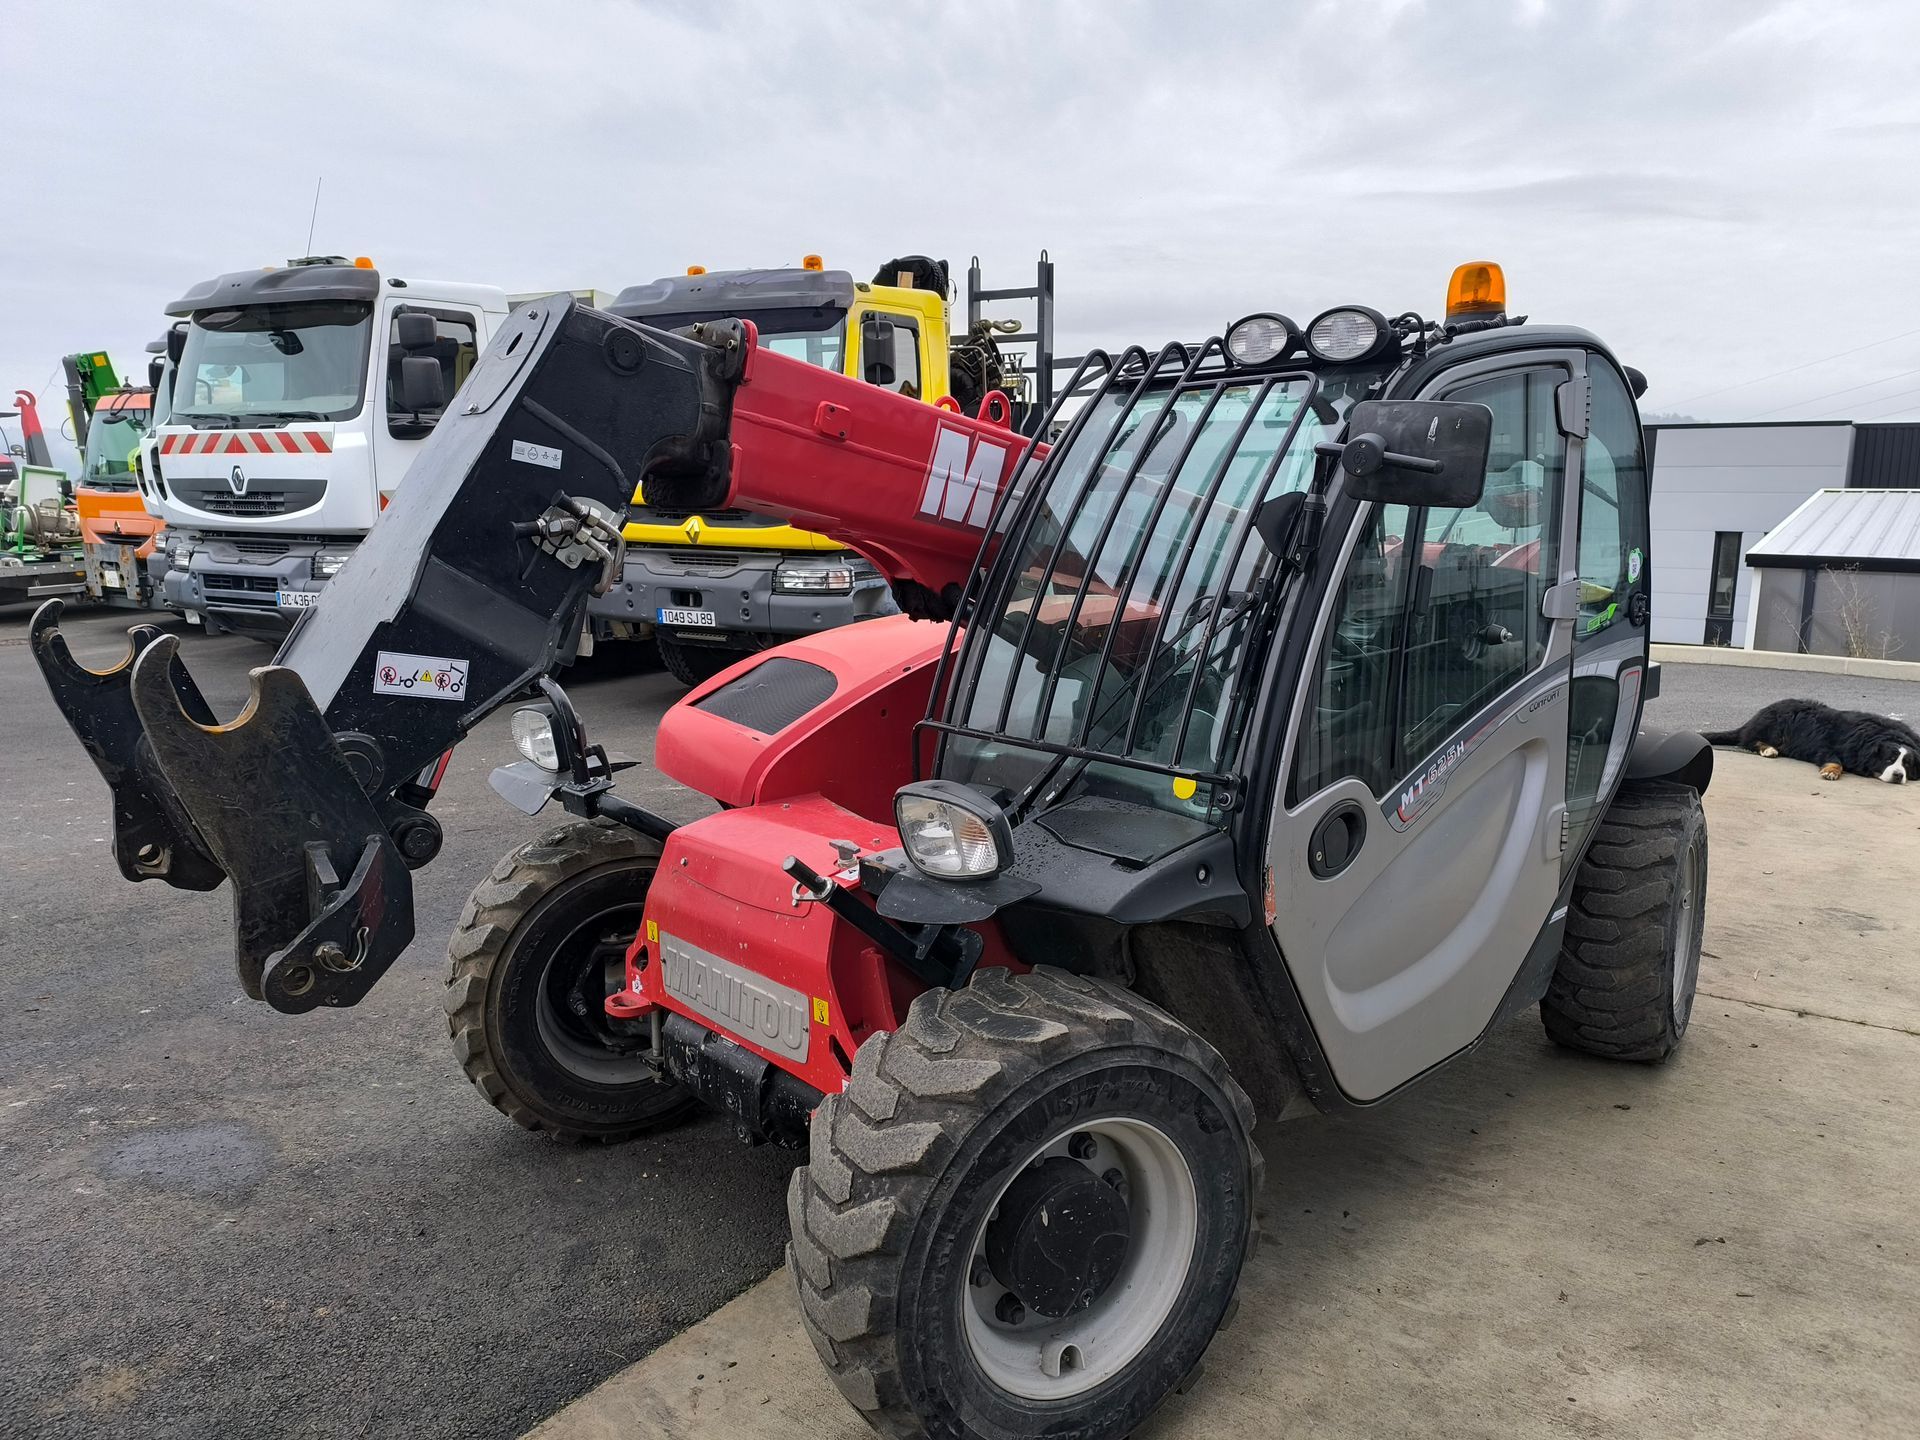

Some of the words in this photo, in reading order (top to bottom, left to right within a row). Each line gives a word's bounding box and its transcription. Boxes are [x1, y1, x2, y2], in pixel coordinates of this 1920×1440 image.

[664, 610, 685, 624] 1049
[686, 612, 699, 625] SJ
[700, 613, 713, 625] 89
[1400, 773, 1426, 811] MT
[664, 945, 804, 1050] MANITOU
